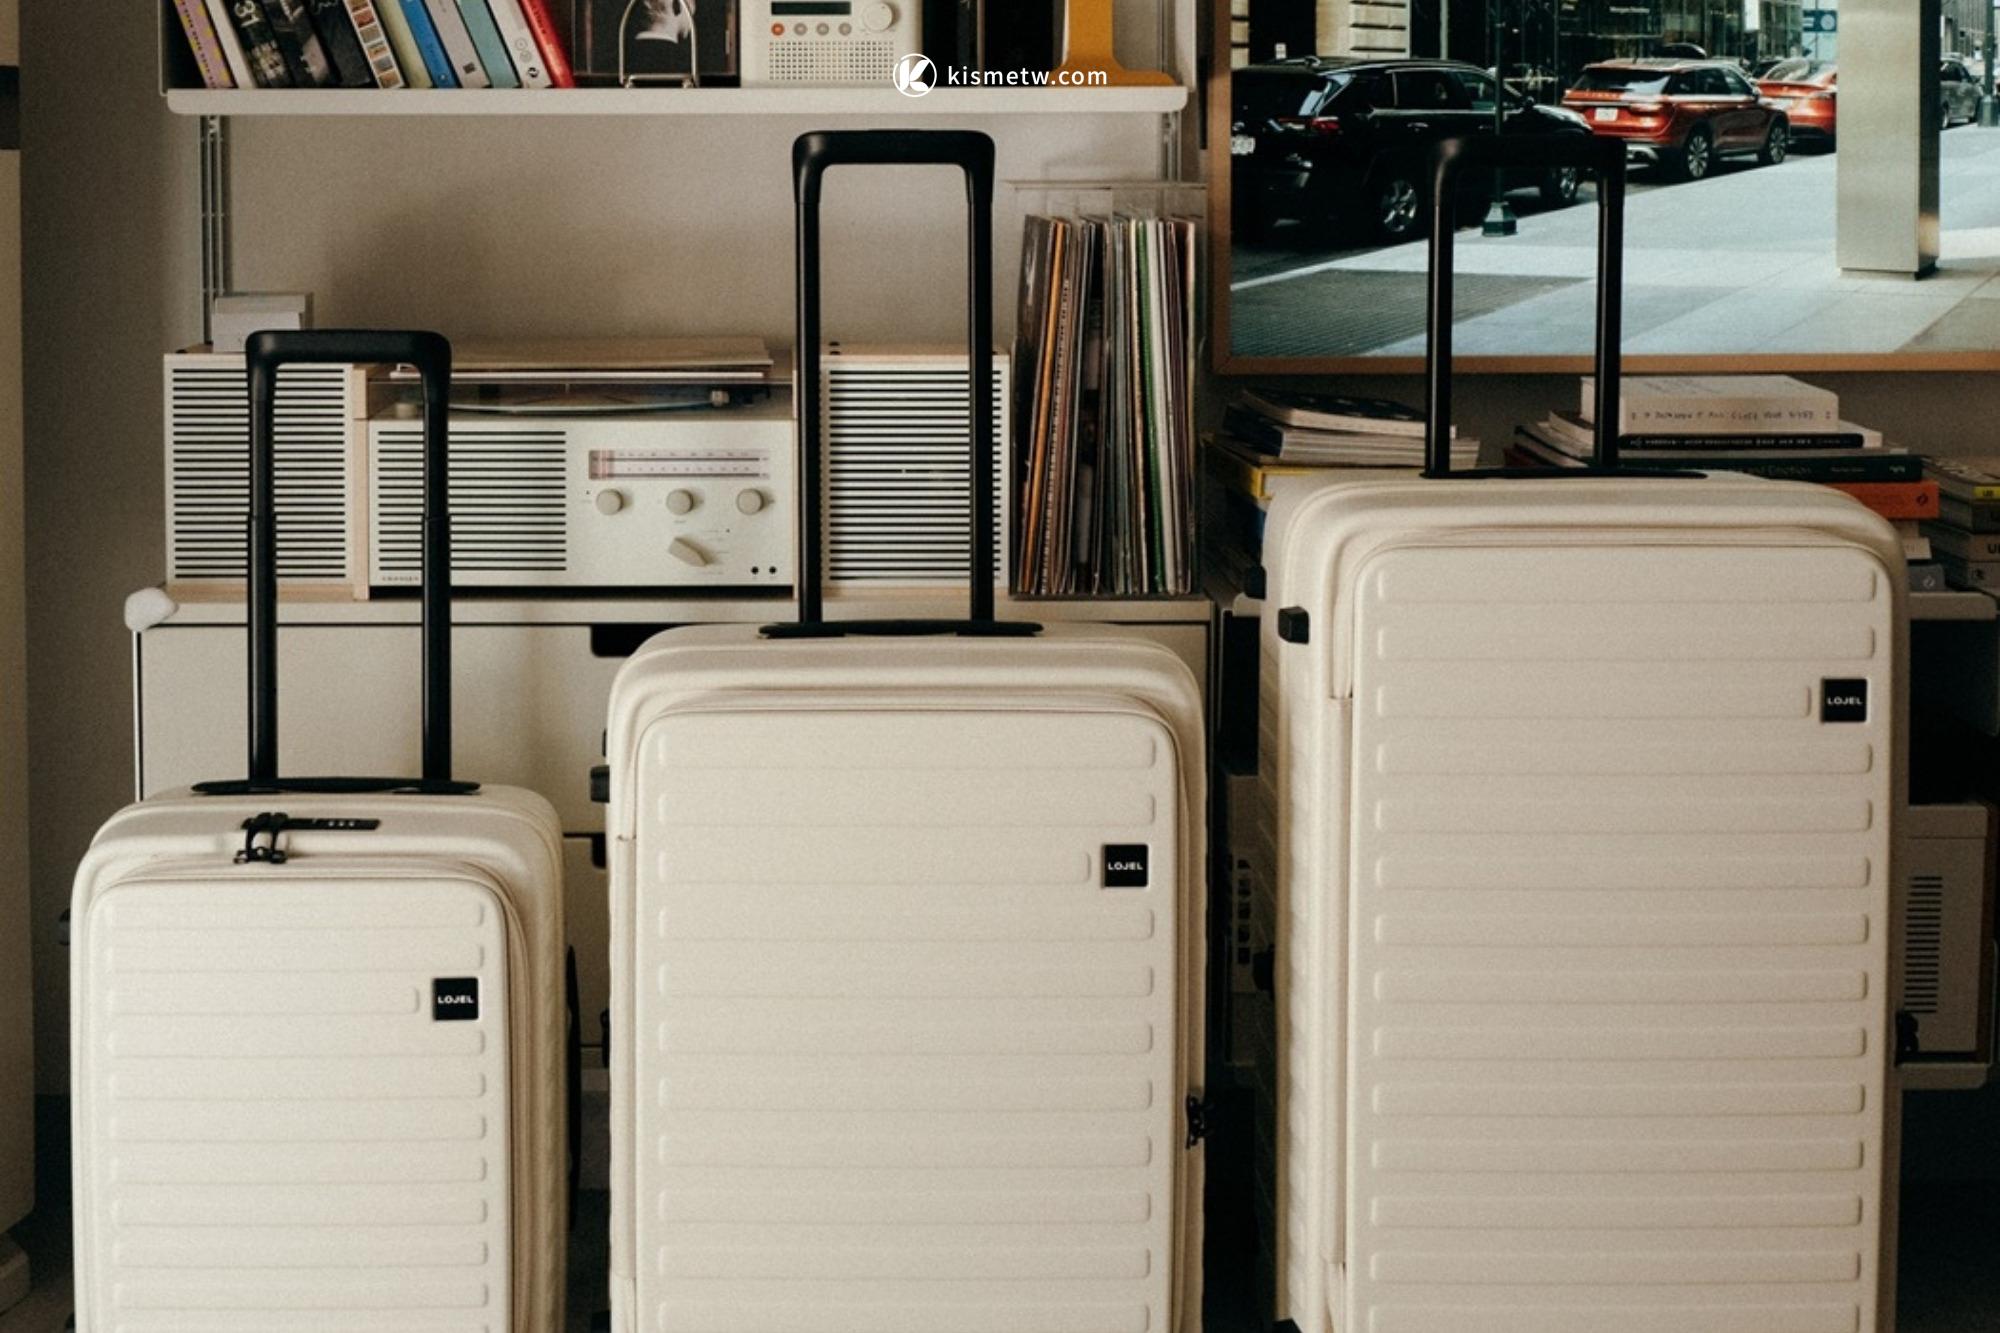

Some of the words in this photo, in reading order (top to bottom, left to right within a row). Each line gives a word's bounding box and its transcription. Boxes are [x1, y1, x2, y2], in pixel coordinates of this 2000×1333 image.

[1827, 695, 1863, 706] LOJEL
[1107, 861, 1144, 871] LOJEL
[437, 994, 475, 1004] LOJEL
